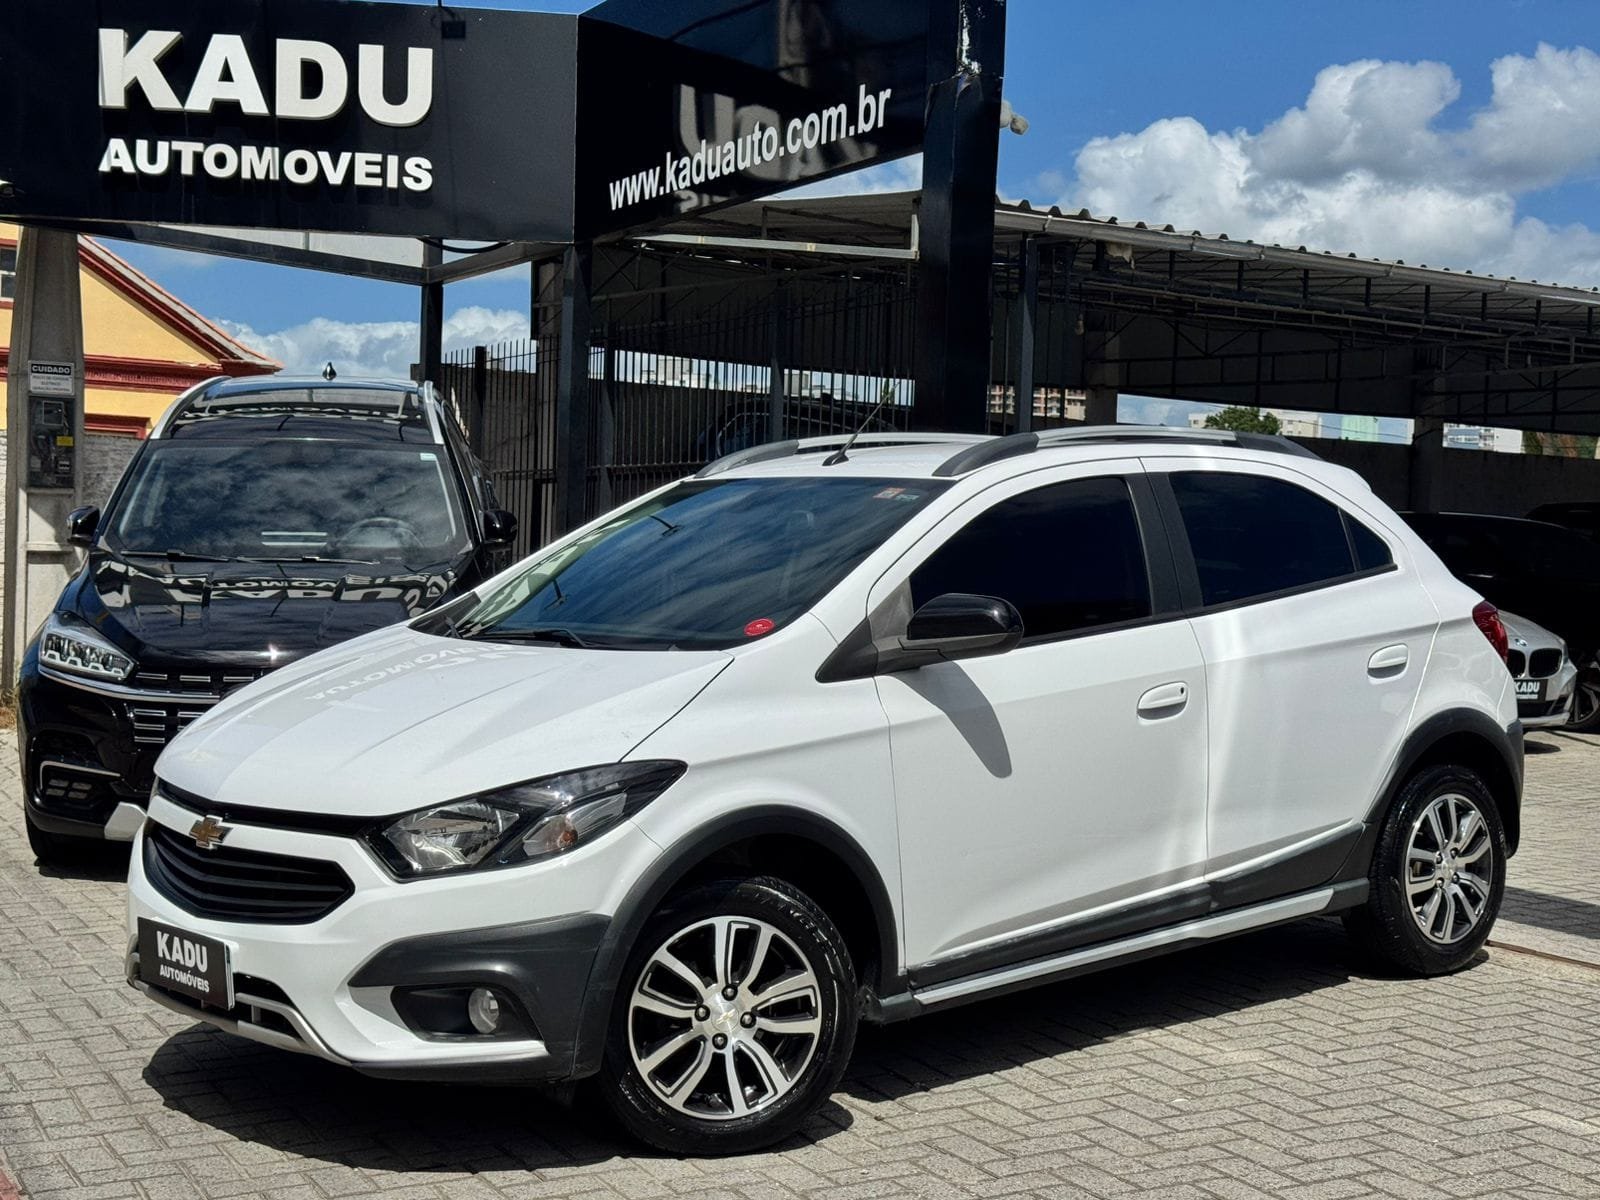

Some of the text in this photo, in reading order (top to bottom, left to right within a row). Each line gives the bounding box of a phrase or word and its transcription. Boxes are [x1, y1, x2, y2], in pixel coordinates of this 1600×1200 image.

[98, 28, 433, 127] KADU
[98, 138, 433, 192] AUTOMOVEIS
[609, 84, 892, 211] www.kaduauto.com.br
[32, 365, 70, 374] CUIDADO
[156, 930, 208, 973] KADU
[160, 963, 210, 993] AUTOMÓVEIS
